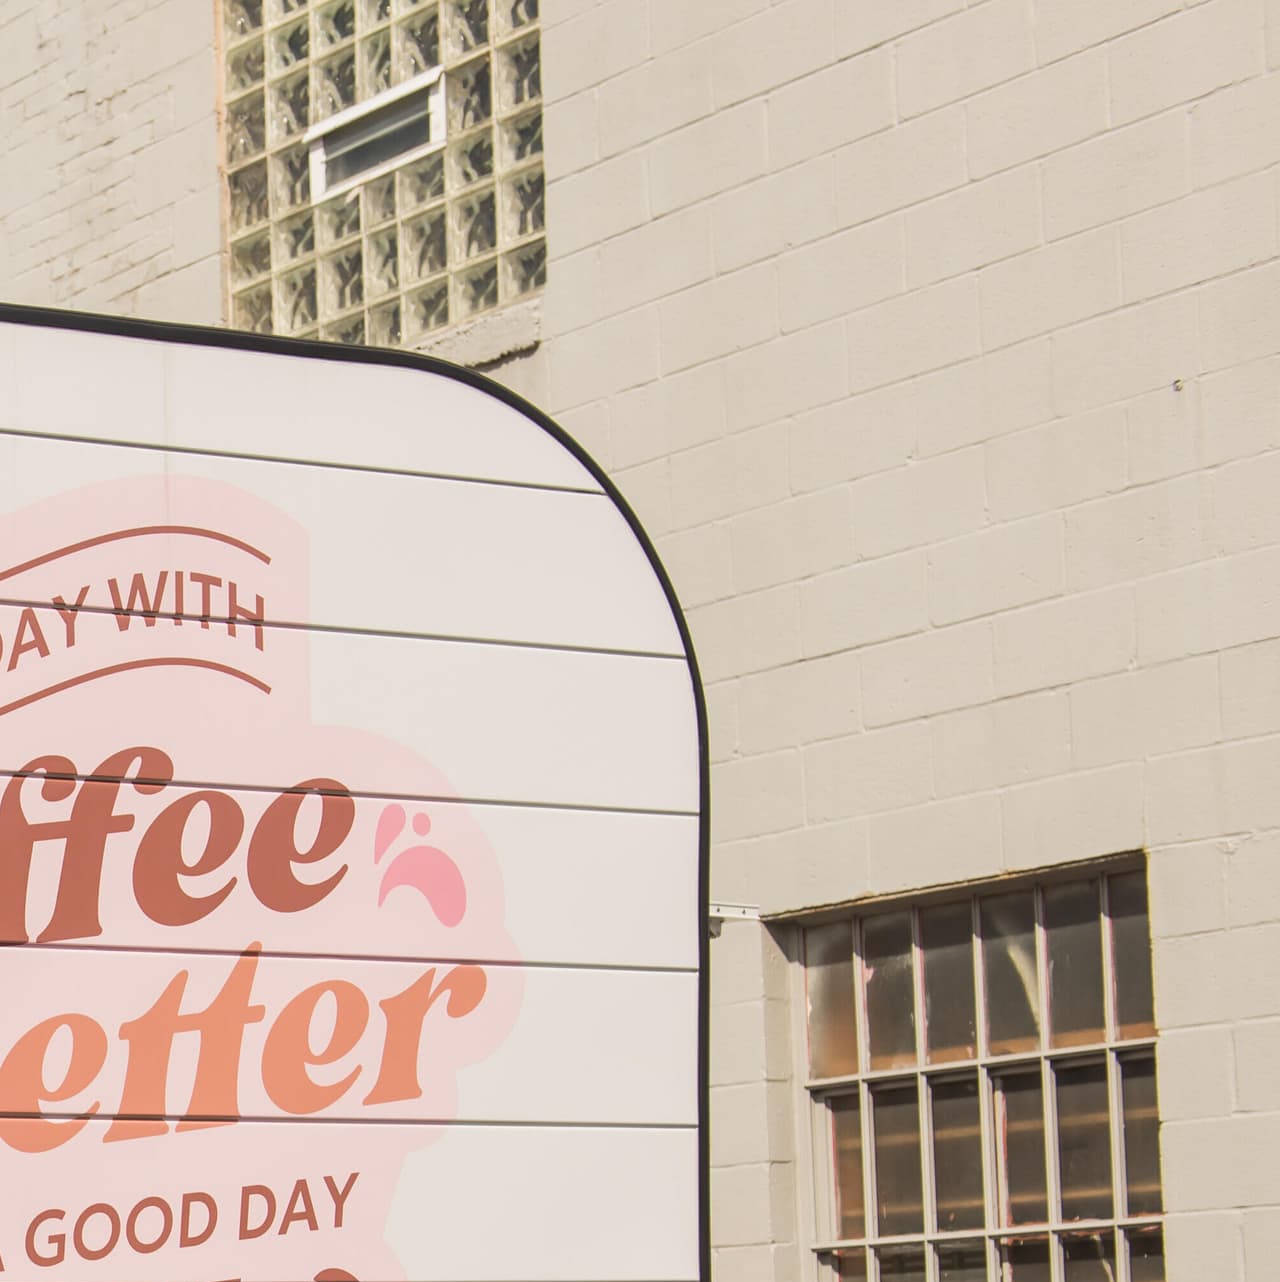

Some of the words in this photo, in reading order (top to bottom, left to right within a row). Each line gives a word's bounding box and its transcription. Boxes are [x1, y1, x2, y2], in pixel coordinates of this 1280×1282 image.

[107, 570, 266, 652] WITH
[24, 1191, 219, 1269] GOOD
[238, 1172, 360, 1241] DAY
